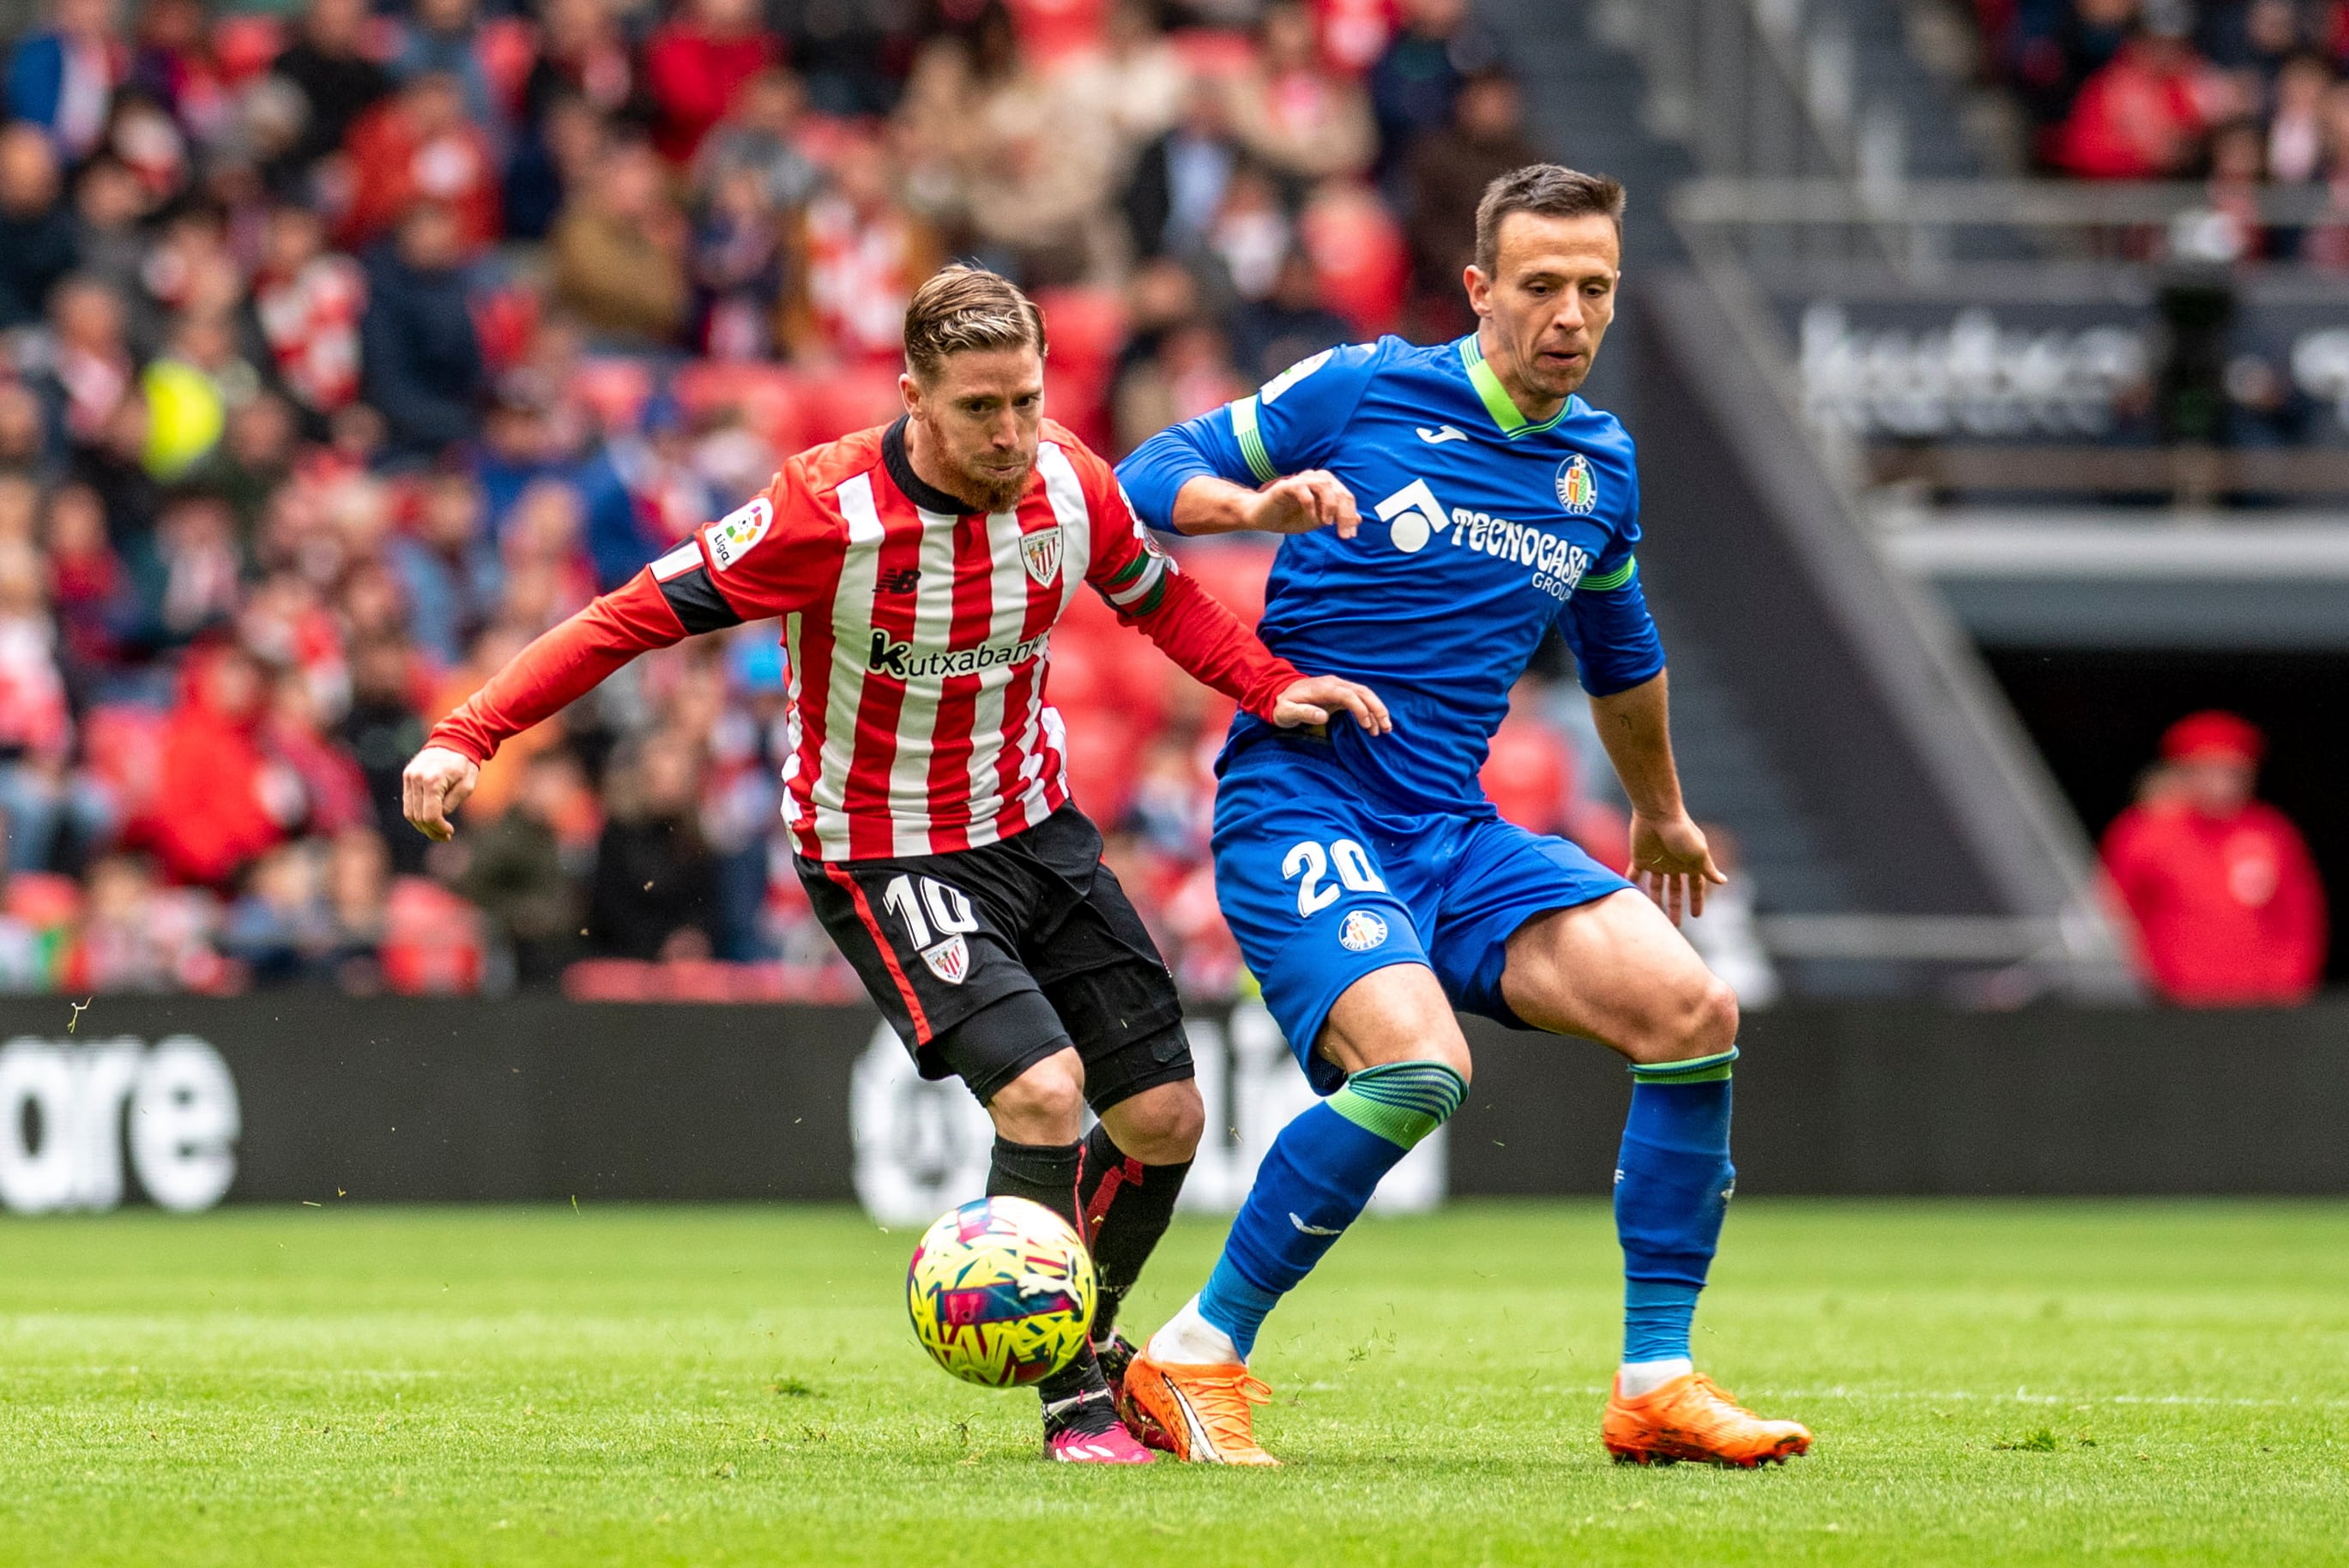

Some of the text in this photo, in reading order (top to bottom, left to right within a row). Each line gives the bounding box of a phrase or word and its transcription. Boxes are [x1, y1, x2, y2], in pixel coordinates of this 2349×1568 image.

[714, 534, 730, 561] Liga
[1452, 508, 1588, 589] TECNOCASA
[1532, 571, 1573, 601] GROUP
[882, 873, 979, 952] 10
[1282, 838, 1387, 919] 20
